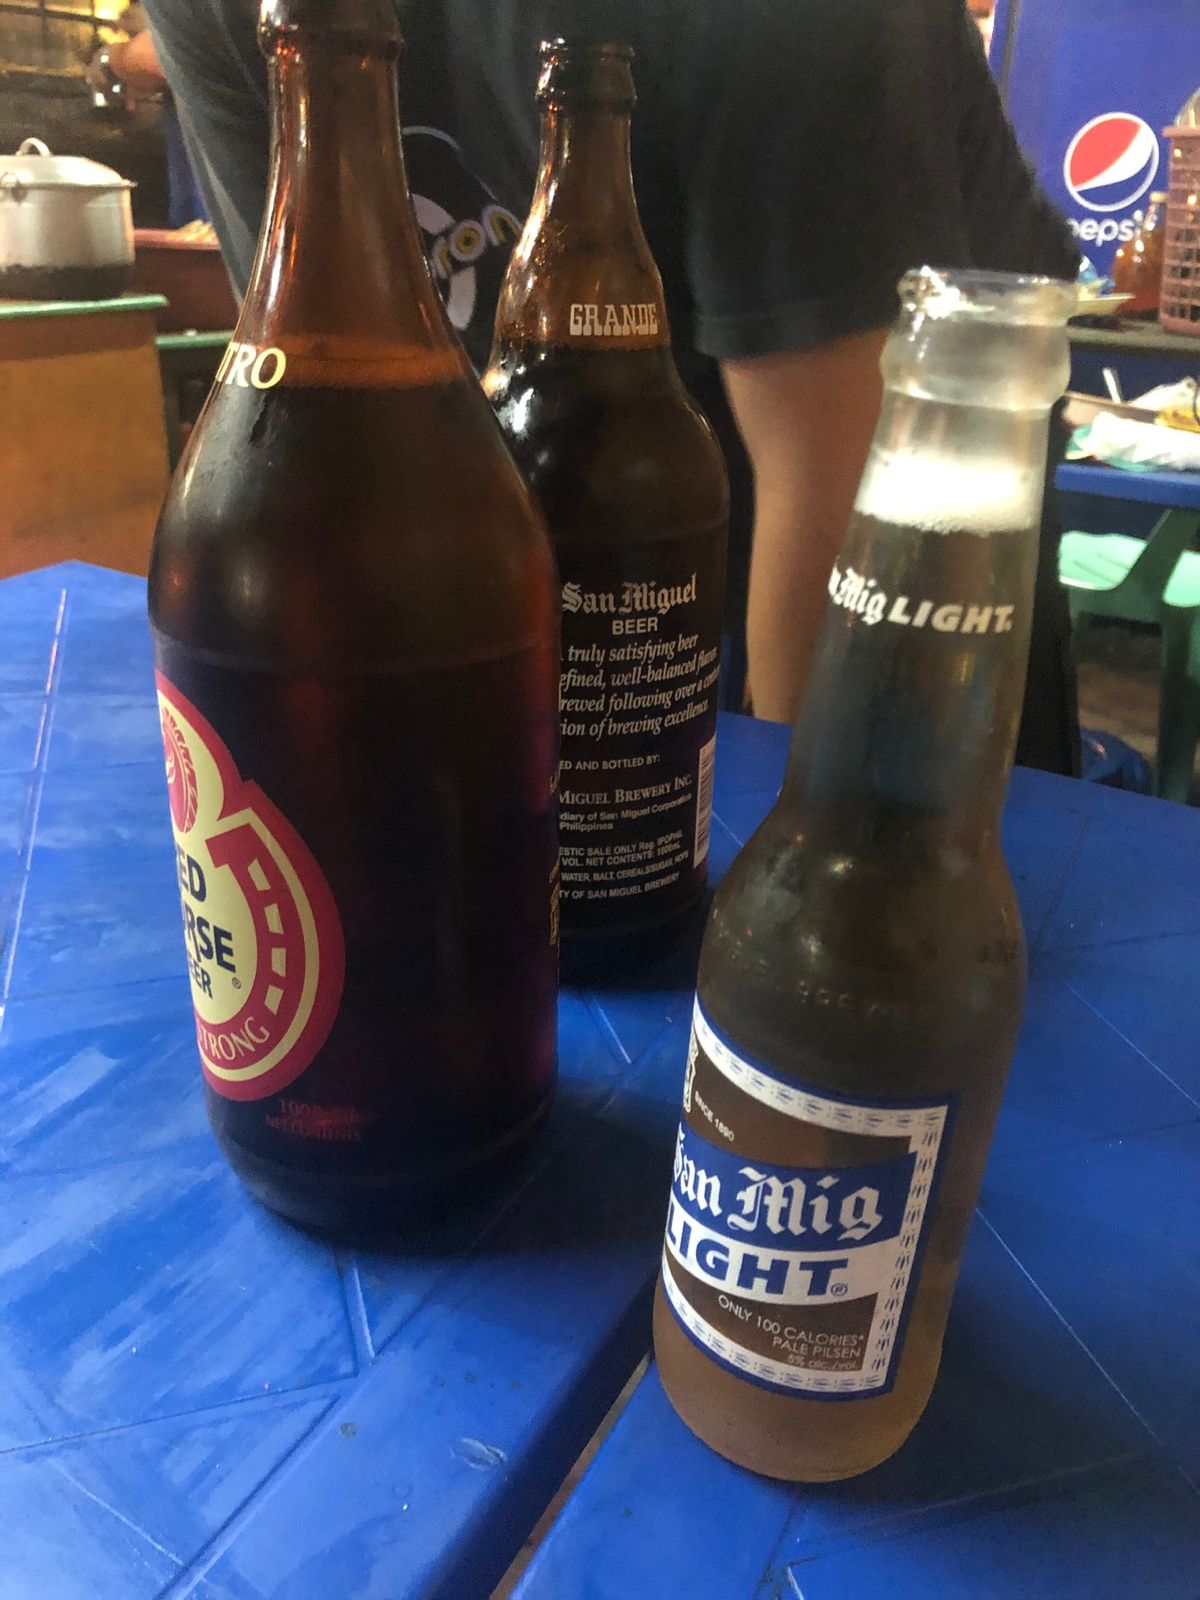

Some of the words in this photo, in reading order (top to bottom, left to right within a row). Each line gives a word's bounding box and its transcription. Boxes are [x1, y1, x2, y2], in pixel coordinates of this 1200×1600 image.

[569, 303, 658, 336] GRANDE
[562, 582, 616, 614] San
[617, 573, 697, 615] Miguel
[612, 617, 658, 635] BEER
[568, 644, 606, 667] truly
[608, 638, 676, 666] satisfying
[677, 633, 699, 652] beer
[611, 653, 697, 686] well-balanced
[558, 692, 605, 713] rewed
[607, 689, 672, 716] following
[674, 684, 697, 700] over
[589, 719, 608, 741] of
[607, 716, 662, 736] brewing
[559, 760, 573, 770] ED
[575, 760, 600, 770] AND
[602, 756, 645, 770] BOTTLED
[646, 754, 661, 765] BY:
[560, 791, 610, 805] MIGUEL
[615, 782, 672, 804] BREWERY
[560, 812, 584, 823] diary
[587, 812, 598, 821] of
[600, 812, 618, 821] San
[621, 806, 650, 819] Miguel
[560, 822, 614, 832] Philippines
[560, 847, 585, 857] ESTIC
[587, 847, 612, 856] SALE
[613, 844, 637, 854] ONLY
[586, 857, 604, 866] NET
[571, 890, 585, 899] OF
[587, 889, 608, 899] SAN
[609, 885, 643, 897] MIGUEL
[727, 1166, 884, 1241] Mig
[718, 1294, 752, 1322] ONLY
[756, 1315, 781, 1334] 100
[772, 1335, 808, 1356] PALE
[812, 1345, 861, 1358] PILSEN
